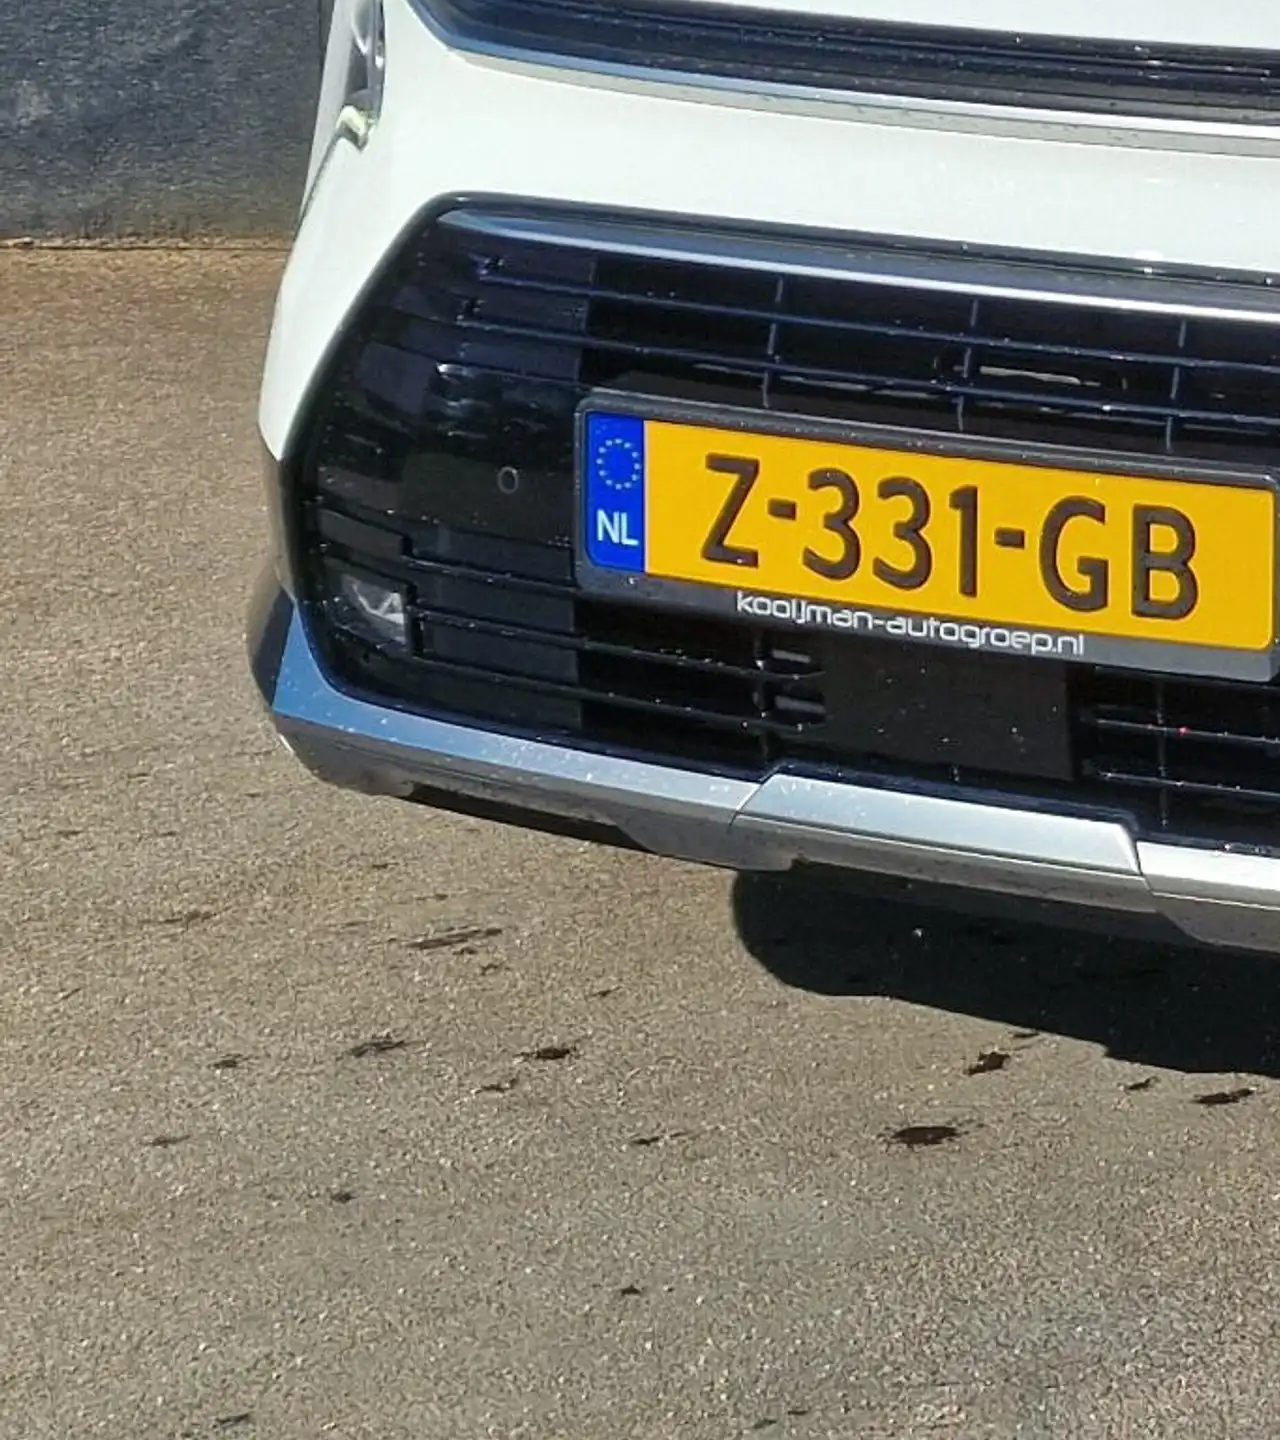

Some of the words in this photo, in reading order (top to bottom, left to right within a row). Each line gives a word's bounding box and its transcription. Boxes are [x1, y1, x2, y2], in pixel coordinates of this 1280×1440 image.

[596, 509, 638, 547] NL
[699, 452, 1199, 620] Z-331-GB
[736, 590, 1085, 656] kooijman-autogroep.nl
